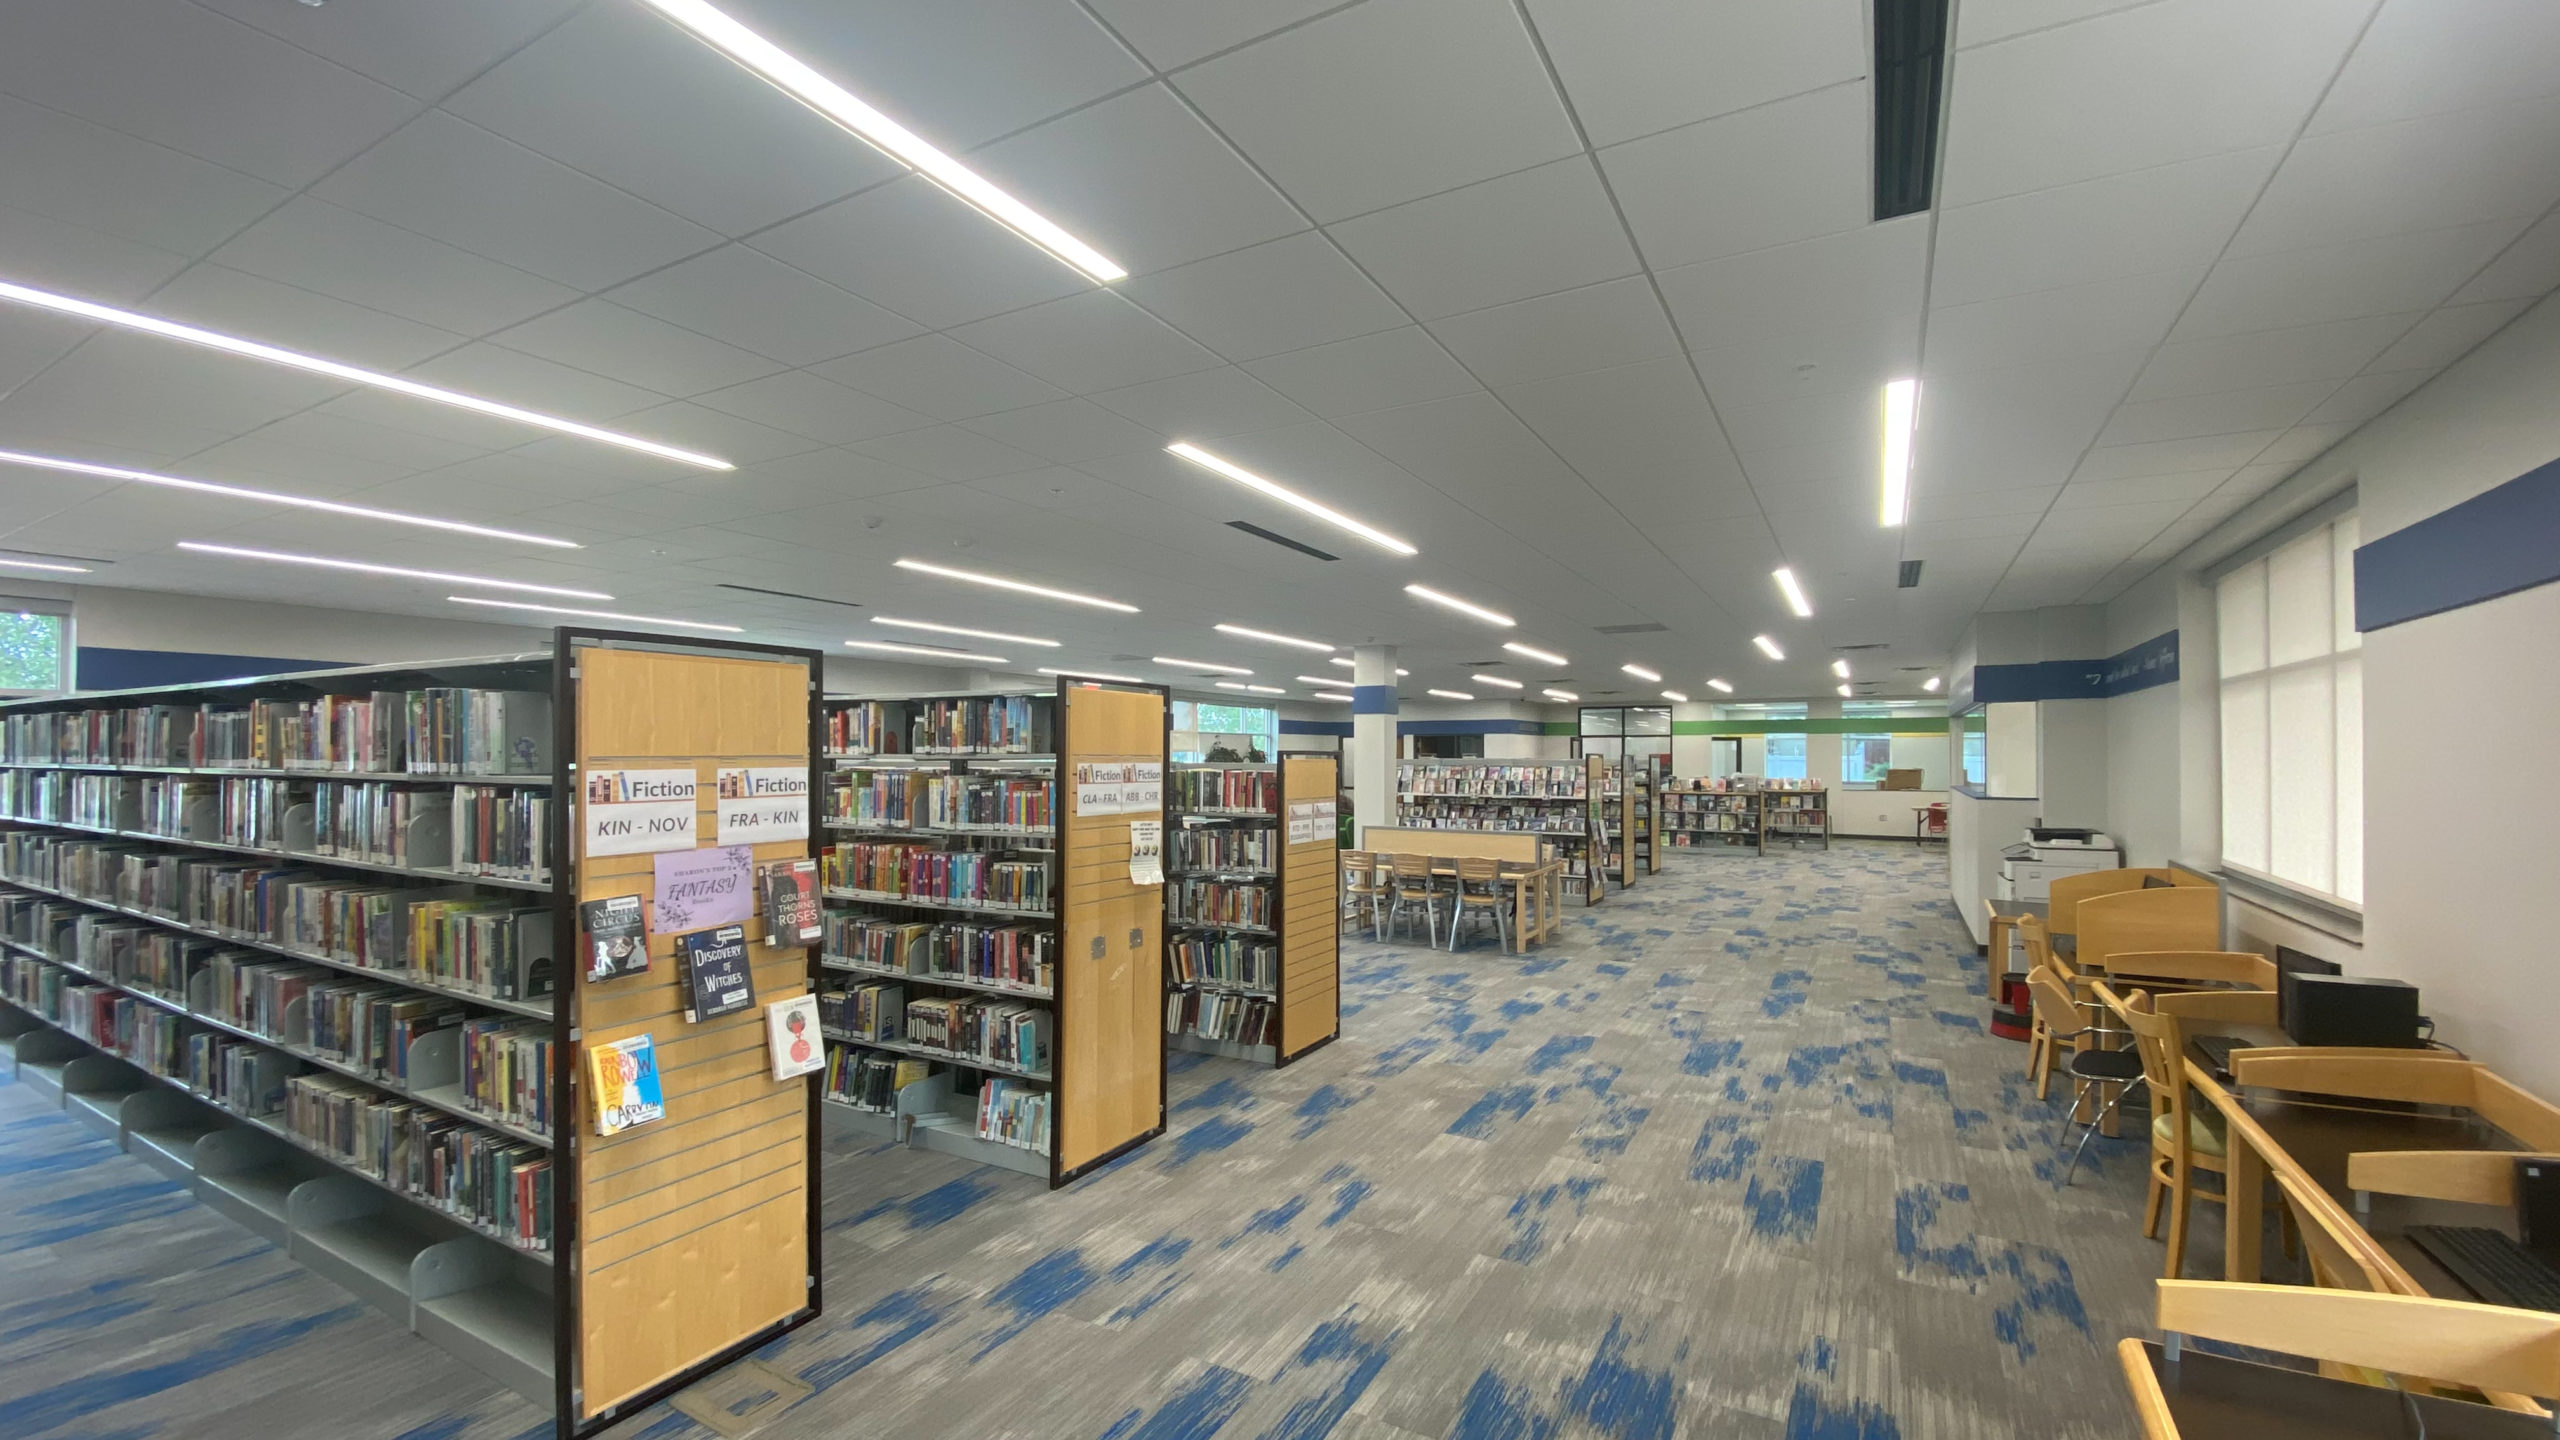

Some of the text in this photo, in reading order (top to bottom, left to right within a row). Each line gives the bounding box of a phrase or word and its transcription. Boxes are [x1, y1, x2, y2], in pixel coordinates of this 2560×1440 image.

[1095, 770, 1121, 781] Fiction
[1137, 769, 1161, 780] Fiction
[632, 781, 695, 797] Fiction
[755, 777, 807, 793] Fiction
[597, 819, 632, 836] KIN
[649, 817, 688, 833] NOV
[729, 812, 759, 828] FRA
[772, 810, 799, 825] KIN
[668, 873, 738, 901] FANTASY
[780, 890, 810, 903] COURT
[777, 900, 816, 913] THORNS
[593, 912, 640, 929] CIRCUS
[778, 909, 818, 926] ROSES
